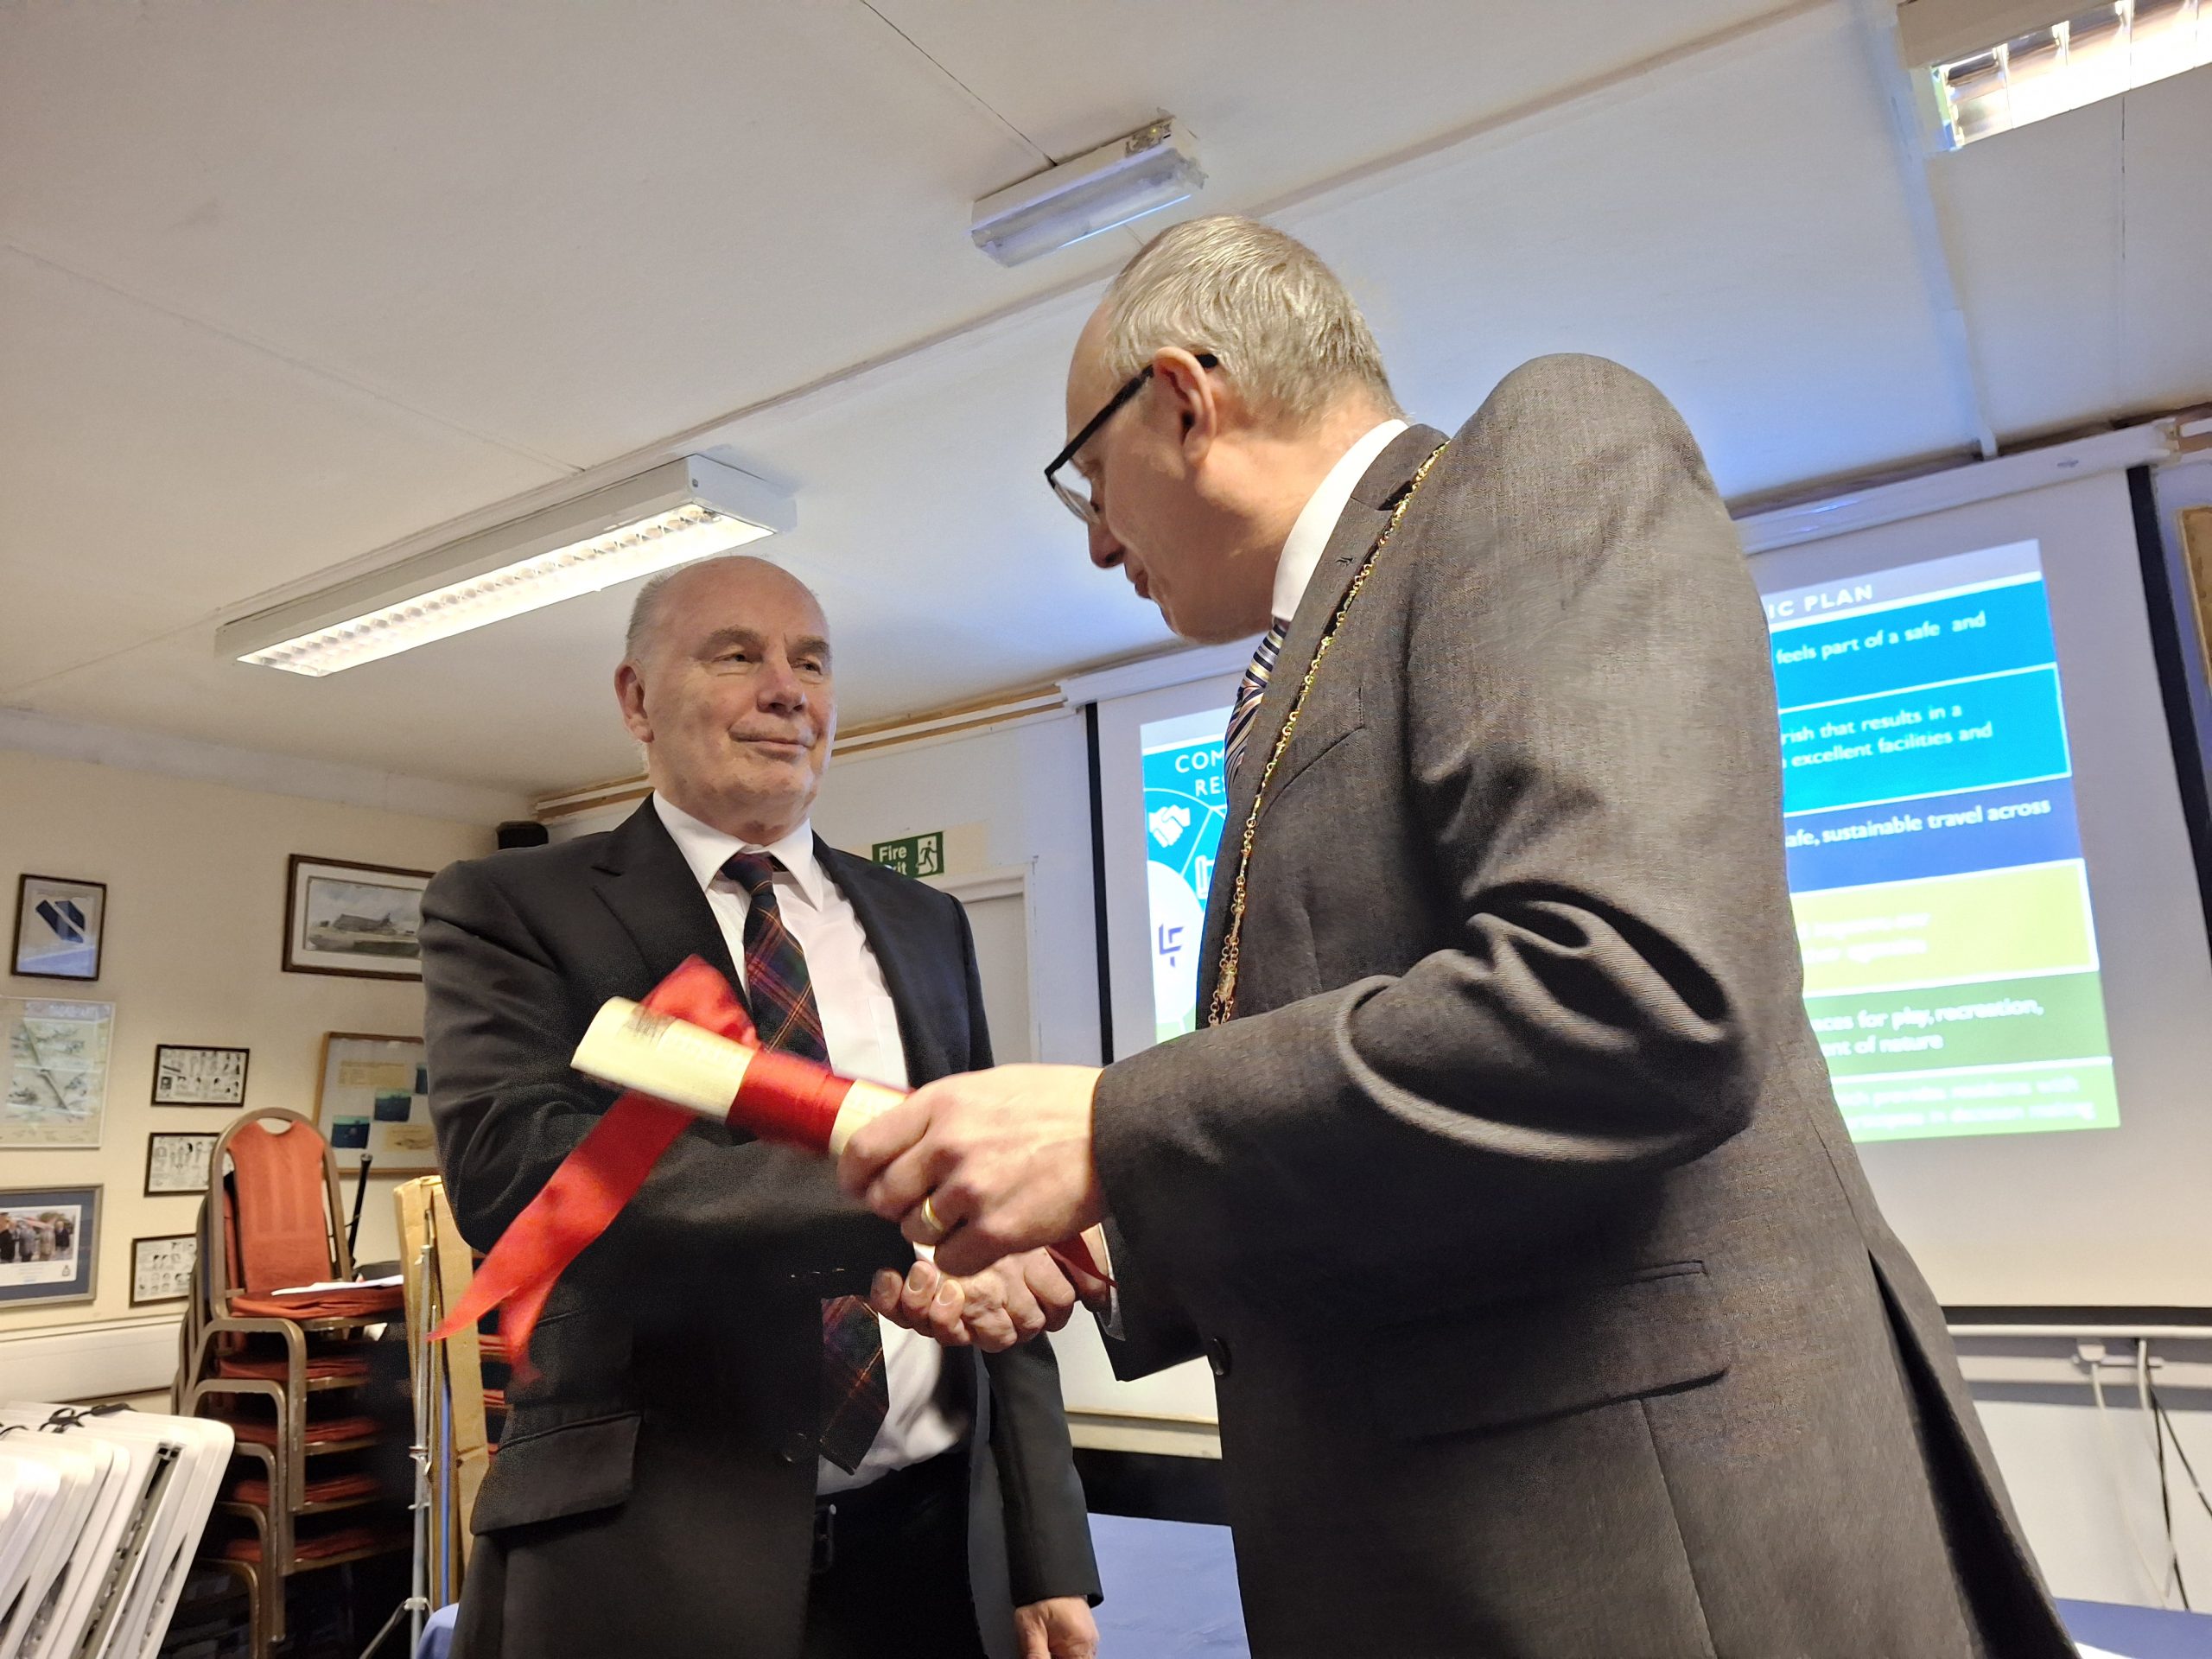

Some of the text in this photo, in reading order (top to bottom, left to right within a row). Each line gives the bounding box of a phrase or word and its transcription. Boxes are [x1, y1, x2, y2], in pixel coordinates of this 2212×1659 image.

[1768, 584, 1872, 619] IC PLAN
[1776, 610, 1986, 664] feels part of a safe and
[1819, 721, 1856, 739] that
[1861, 709, 1923, 732] results
[1928, 705, 1946, 721] in
[1952, 705, 1962, 718] a
[1791, 743, 1873, 767] excellent
[1878, 732, 1954, 753] facilities
[1959, 721, 1993, 741] and
[1822, 815, 1923, 843] sustainable
[1927, 804, 1984, 830] travel
[1986, 800, 2051, 822] across
[879, 845, 907, 862] Fire
[1857, 1009, 1889, 1028] for
[1854, 1034, 1876, 1054] of
